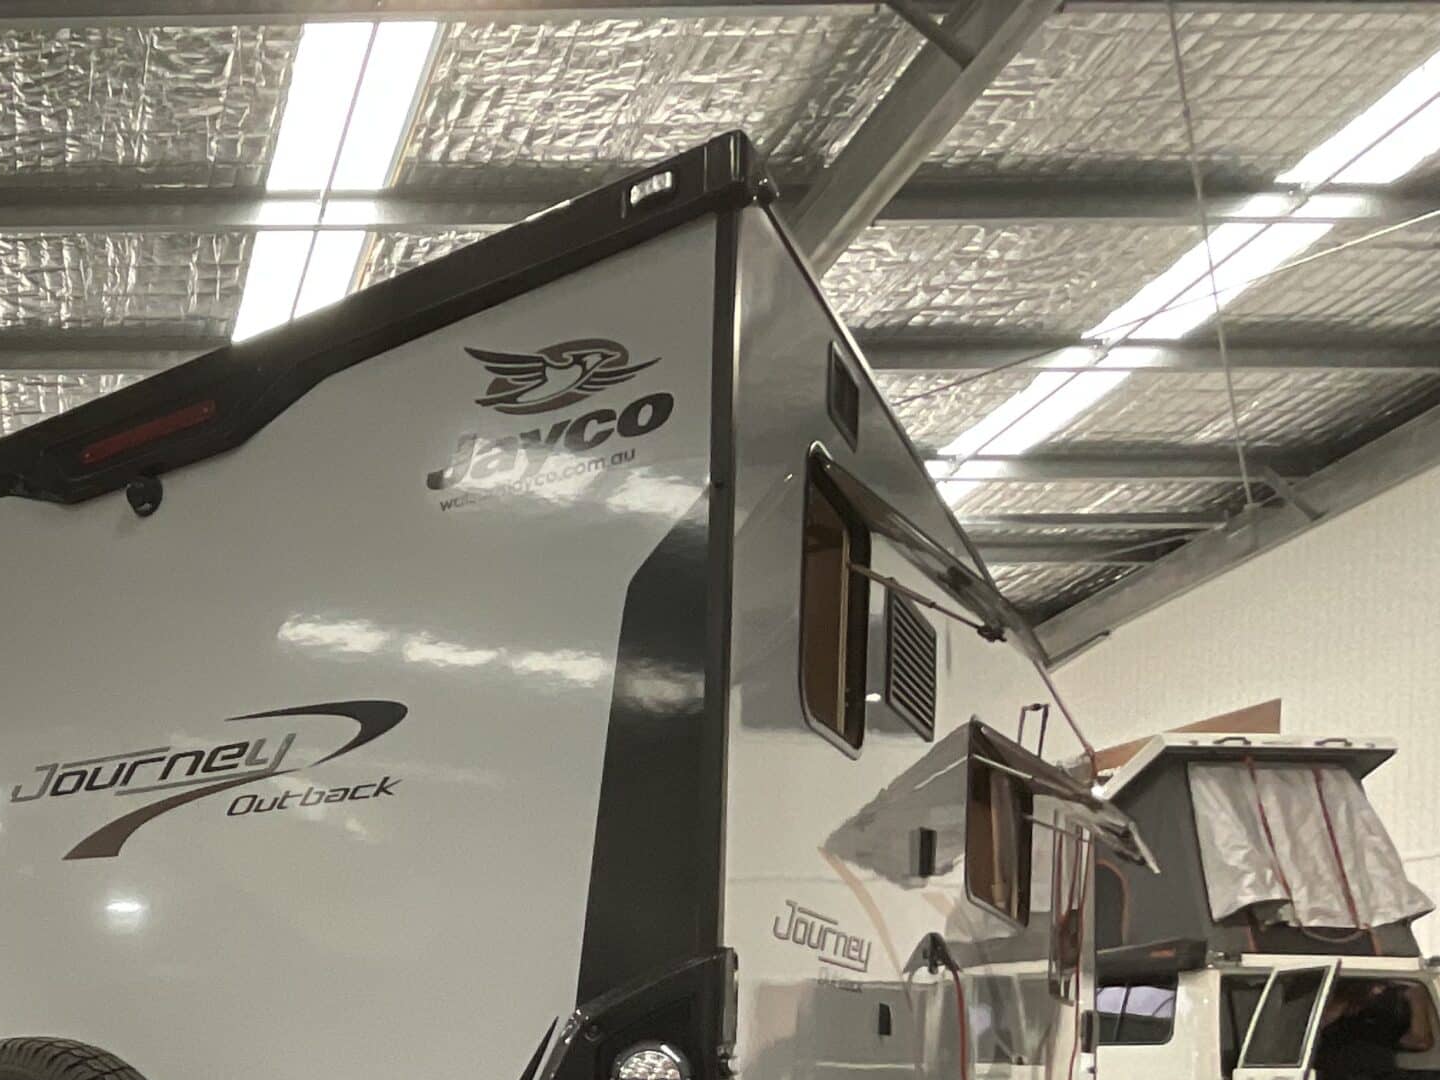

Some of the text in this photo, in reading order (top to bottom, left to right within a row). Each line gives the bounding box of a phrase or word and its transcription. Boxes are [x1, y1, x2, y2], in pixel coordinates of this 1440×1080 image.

[427, 392, 674, 490] Jayco
[11, 732, 297, 803] Journey
[226, 776, 403, 817] Outback
[772, 899, 872, 973] Journey
